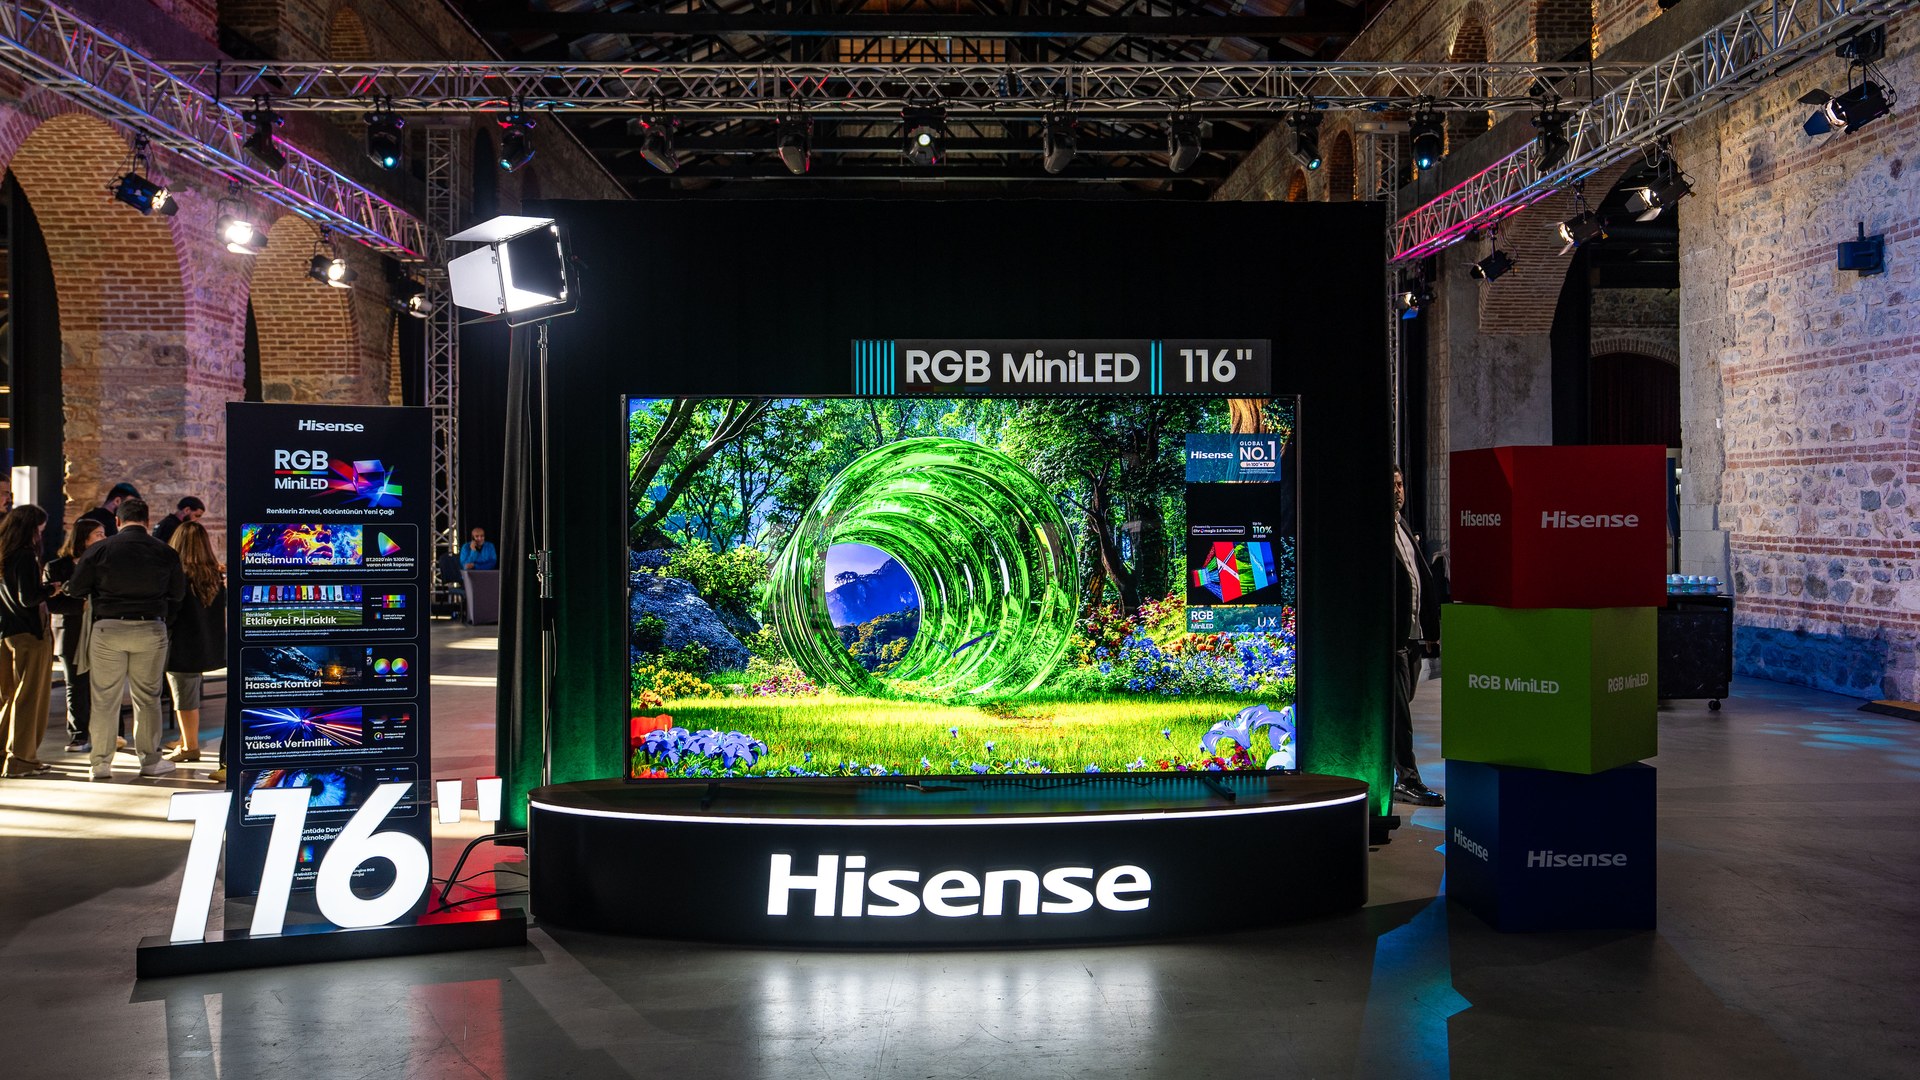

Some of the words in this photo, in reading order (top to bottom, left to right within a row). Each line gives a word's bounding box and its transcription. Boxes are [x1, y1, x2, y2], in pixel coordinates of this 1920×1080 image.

[906, 349, 992, 384] RGB
[1002, 349, 1141, 384] MiniLED
[1179, 348, 1253, 383] 116"
[298, 419, 364, 433] Hisense
[1190, 451, 1234, 459] Hisense
[1240, 441, 1276, 460] NO.1
[274, 449, 329, 471] RGB
[274, 477, 329, 490] MiniLED
[379, 508, 395, 516] Çağı
[1460, 510, 1501, 527] Hisense
[1541, 511, 1639, 529] Hisense
[1252, 526, 1273, 534] 110%
[245, 555, 303, 564] Maksimum
[305, 556, 354, 566] Kapsama
[245, 616, 291, 627] Etkileyici
[293, 616, 337, 625] Parlaklık
[1191, 611, 1214, 620] RGB
[245, 681, 282, 690] Hassas
[284, 679, 322, 689] Kontrol
[1468, 674, 1500, 690] RGB
[1504, 677, 1560, 694] MiniLED
[1608, 678, 1624, 693] RGB
[1625, 673, 1649, 689] MiniLED
[245, 740, 283, 750] Yüksek
[284, 738, 332, 748] Verimlilik
[302, 827, 325, 835] üntüde
[1453, 827, 1489, 862] Hisense
[167, 777, 502, 943] 116"
[1527, 850, 1628, 868] Hisense
[766, 853, 1152, 918] Hisense
